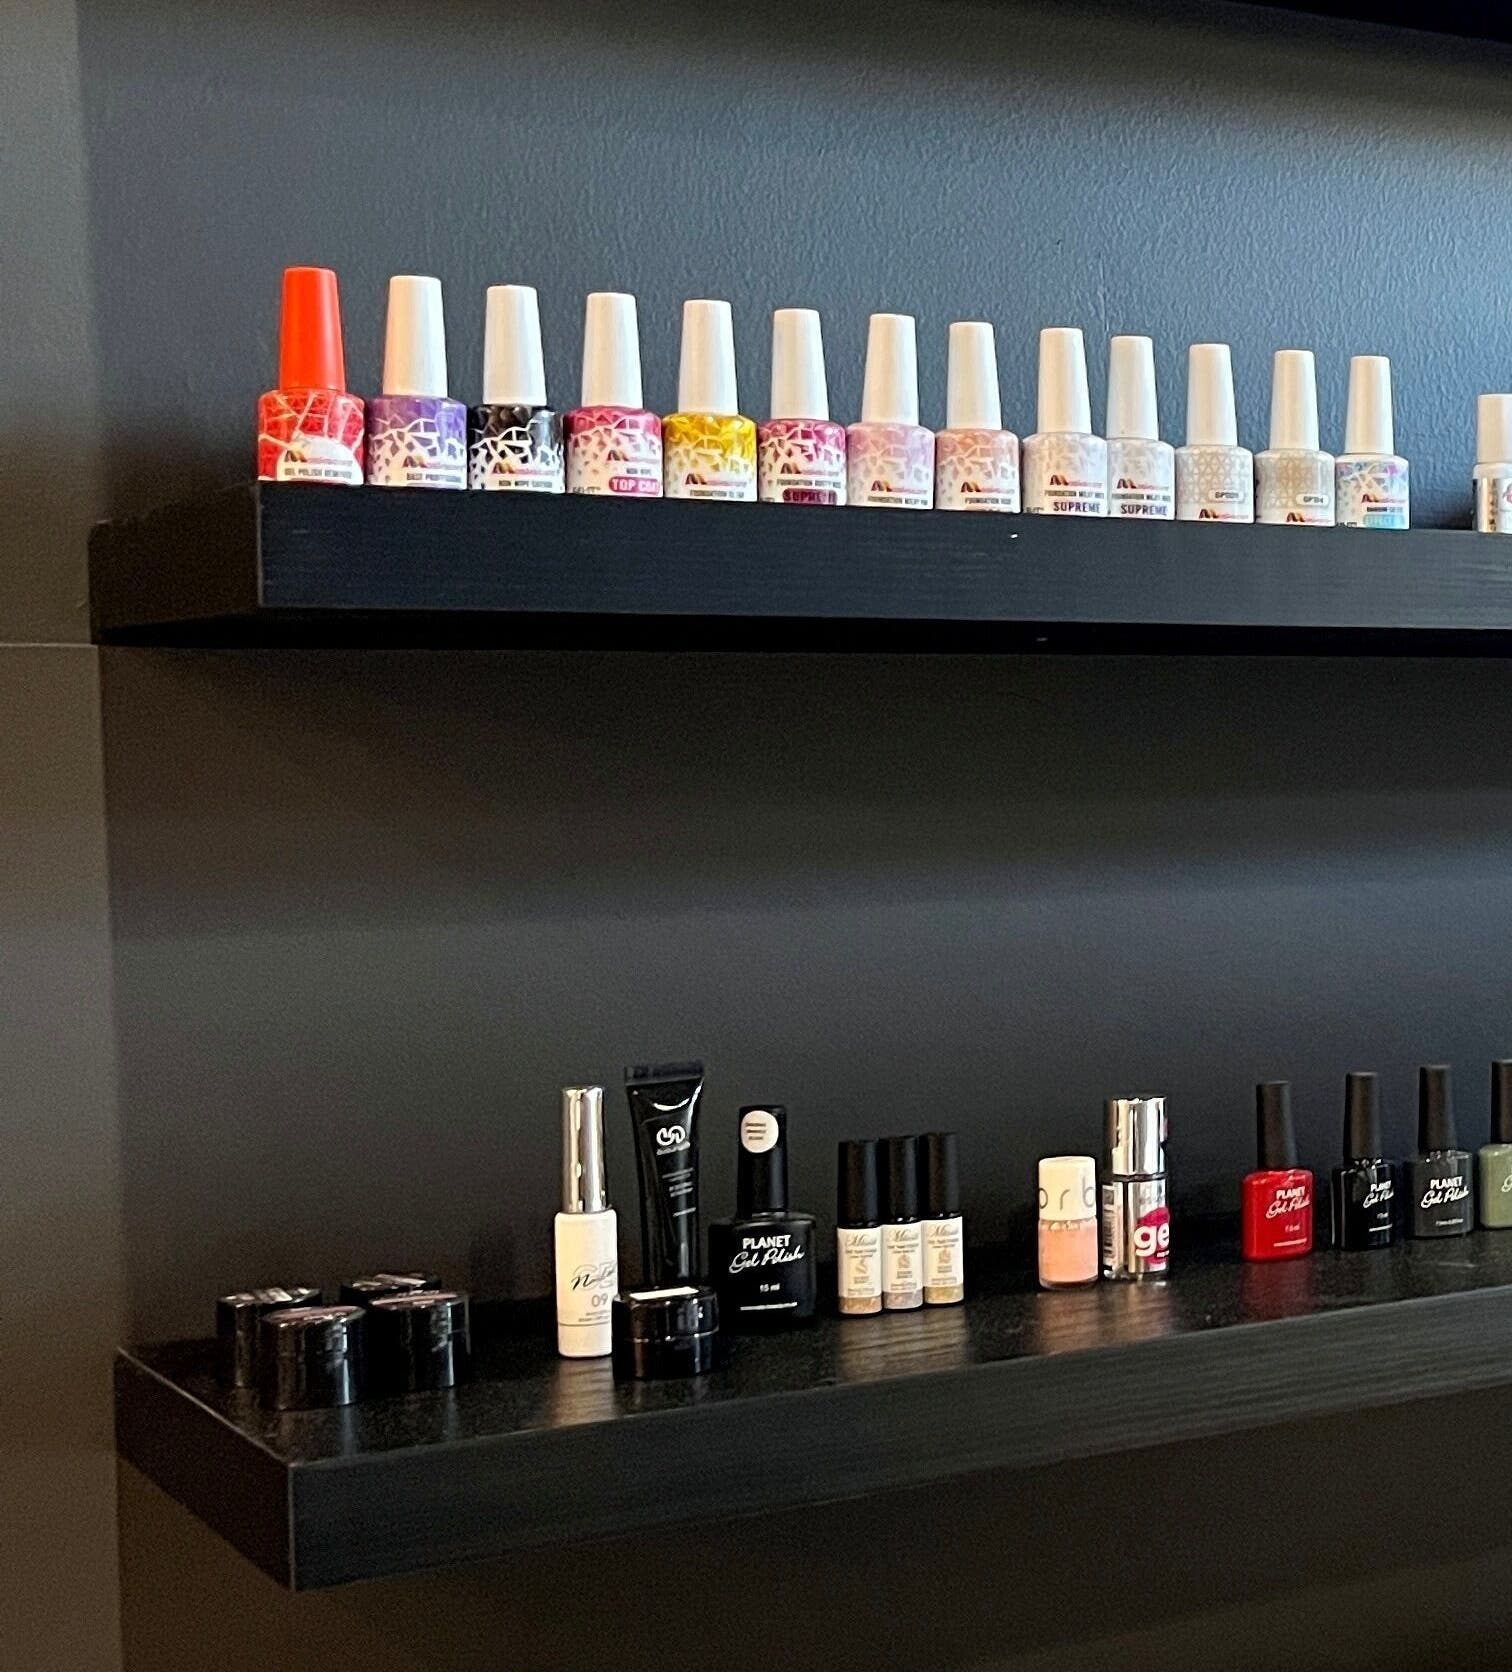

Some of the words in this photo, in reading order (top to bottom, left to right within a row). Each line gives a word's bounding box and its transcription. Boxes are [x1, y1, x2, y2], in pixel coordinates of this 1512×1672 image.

[612, 478, 637, 492] TOP
[1053, 501, 1101, 514] SUPREME
[1120, 503, 1168, 516] SUPREME
[1430, 1176, 1463, 1189] PLANET
[1276, 1186, 1306, 1199] PLANET
[742, 1234, 792, 1250] PLANET
[728, 1251, 761, 1274] Gel
[761, 1245, 805, 1266] Polish
[591, 1293, 609, 1308] 09
